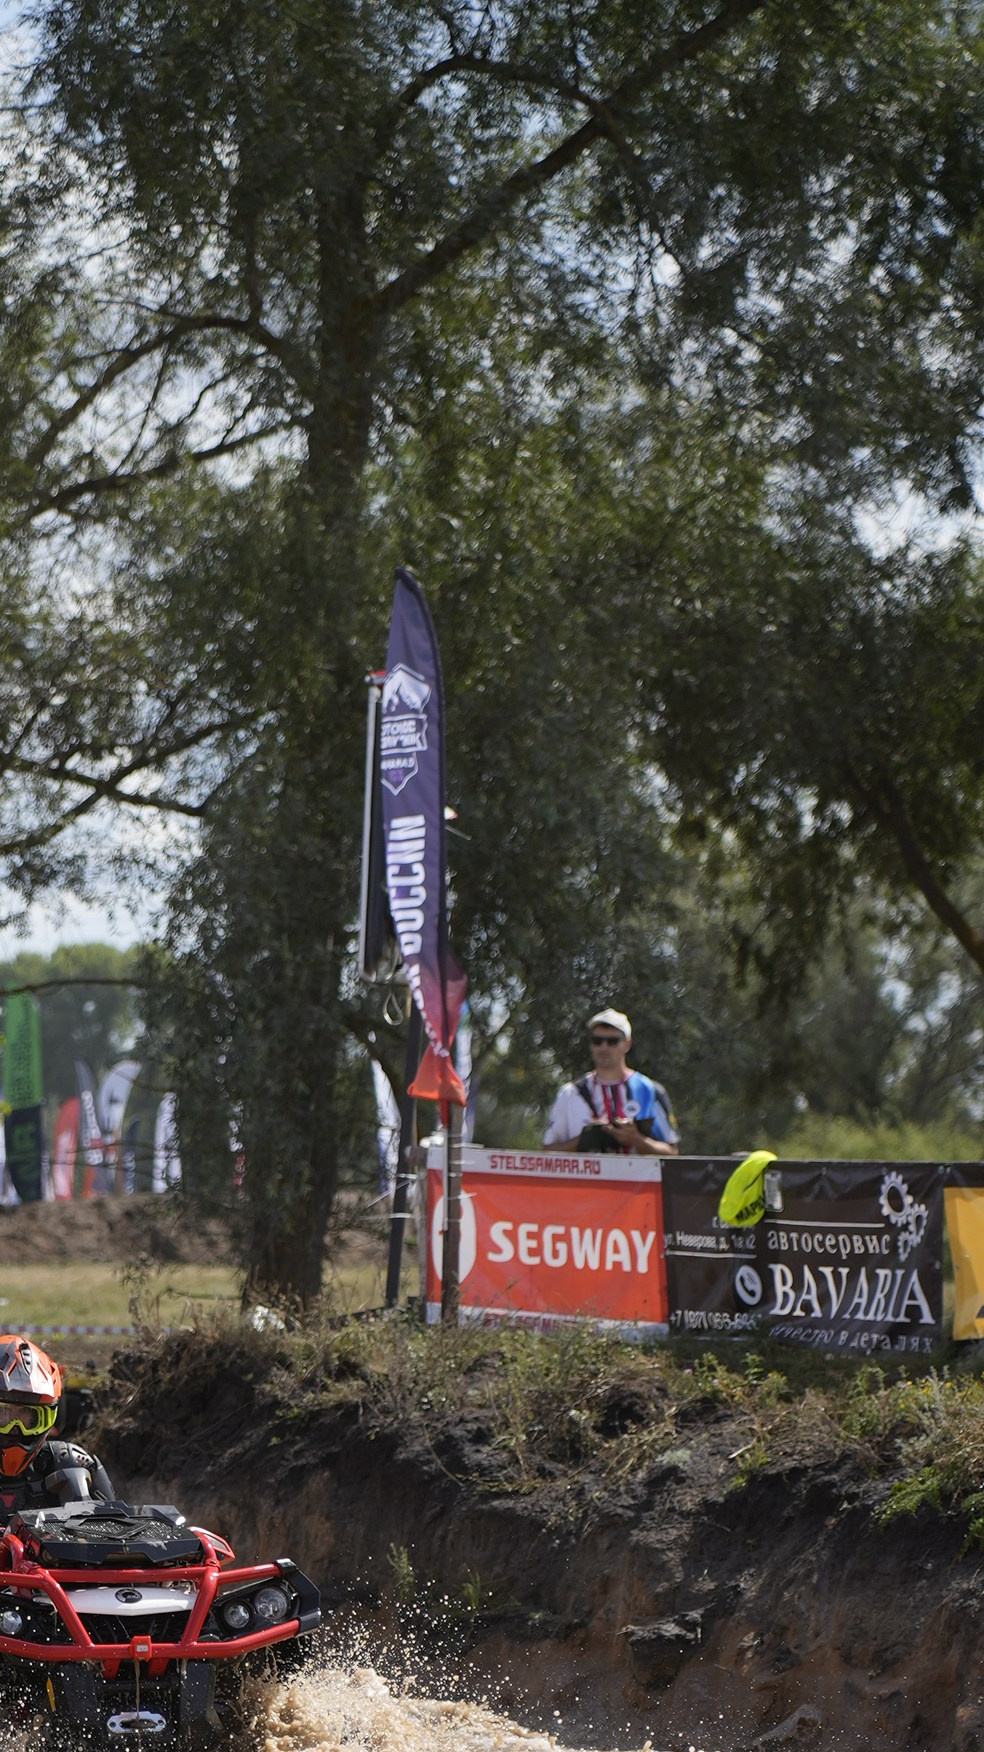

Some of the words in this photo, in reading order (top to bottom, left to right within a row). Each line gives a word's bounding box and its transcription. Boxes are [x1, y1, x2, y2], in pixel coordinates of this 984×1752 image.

[489, 1154, 601, 1175] STELSSAMARA.RU
[487, 1220, 657, 1274] SEGWAY
[767, 1230, 891, 1259] автосервис
[768, 1263, 936, 1325] BAVARIA
